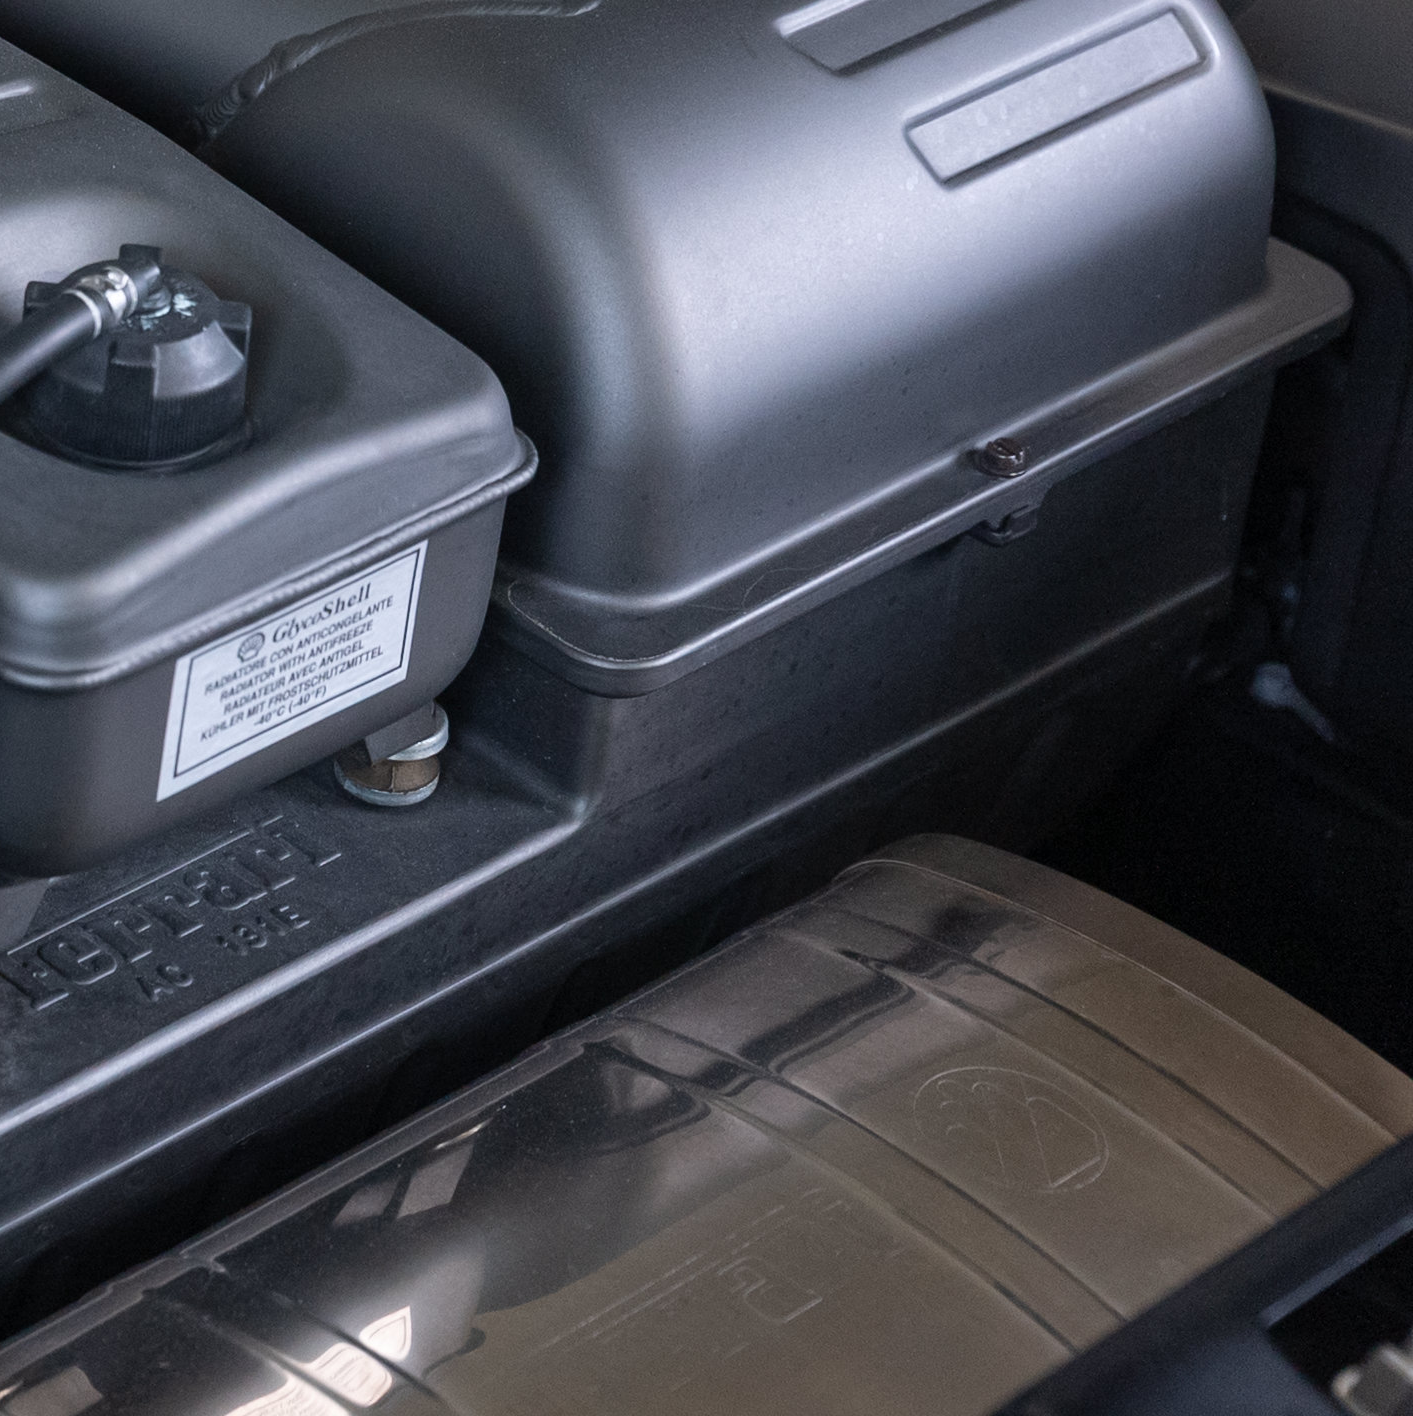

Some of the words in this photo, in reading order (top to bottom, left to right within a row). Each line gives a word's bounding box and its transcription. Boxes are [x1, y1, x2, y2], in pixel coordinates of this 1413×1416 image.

[204, 655, 268, 696] RADIATORE
[268, 643, 294, 664] CON
[296, 593, 394, 652] ANTICONGELANTE
[270, 580, 372, 649] GlycoShell
[199, 709, 244, 742] KÜHLER
[246, 700, 265, 719] MIT
[267, 642, 384, 711] FROSTSCHUTZMITTEL
[219, 666, 276, 703] RADIATOR
[277, 651, 306, 675] WITH
[306, 618, 374, 661] ANTIFREEZE
[222, 675, 286, 716] RADIATEUR
[288, 660, 317, 684] AVEC
[319, 637, 364, 669] ANTIGEL
[253, 704, 285, 729] -40°C
[287, 683, 327, 714] (-40°F)
[137, 962, 193, 1001] AC
